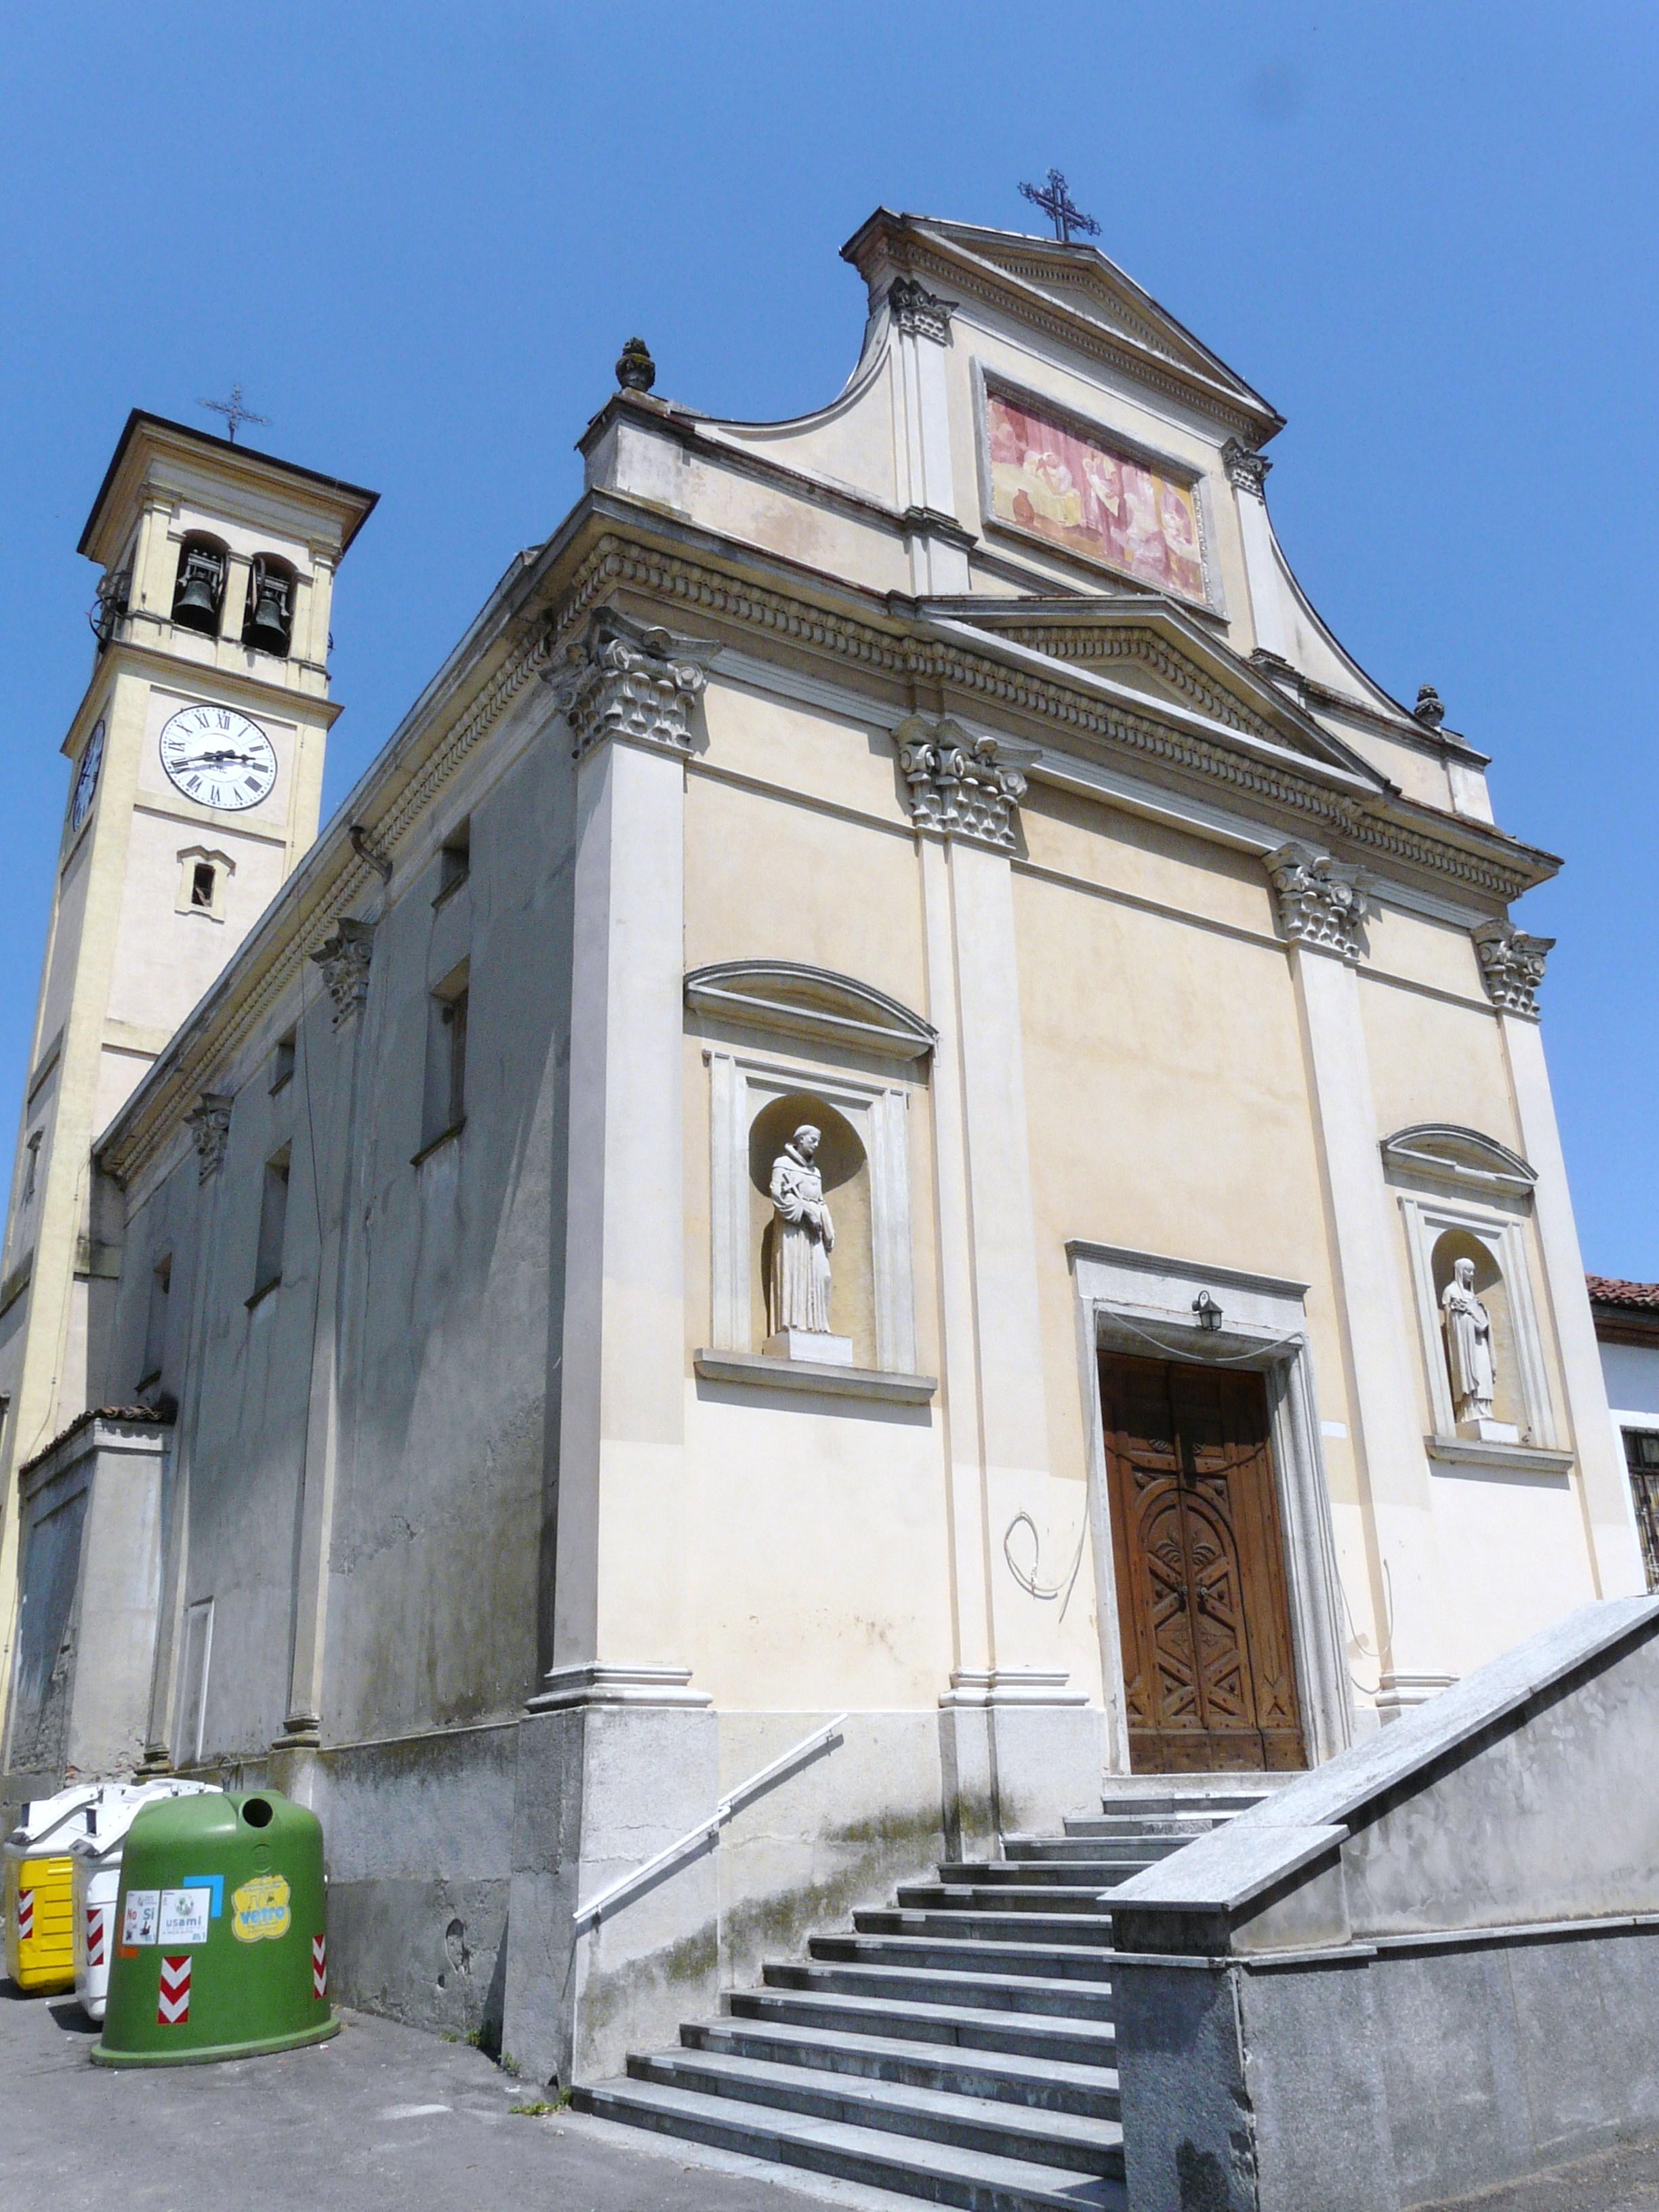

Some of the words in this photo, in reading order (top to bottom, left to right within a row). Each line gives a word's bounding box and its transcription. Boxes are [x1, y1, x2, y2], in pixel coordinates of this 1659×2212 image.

[176, 720, 193, 737] X
[194, 713, 210, 729] XI
[216, 714, 230, 730] XII
[238, 726, 248, 737] I
[168, 739, 186, 752] IX
[252, 762, 269, 773] III
[186, 775, 203, 793] VII
[210, 785, 220, 802] VI
[233, 786, 243, 802] V
[127, 1908, 138, 1920] No
[241, 1906, 284, 1924] vetro
